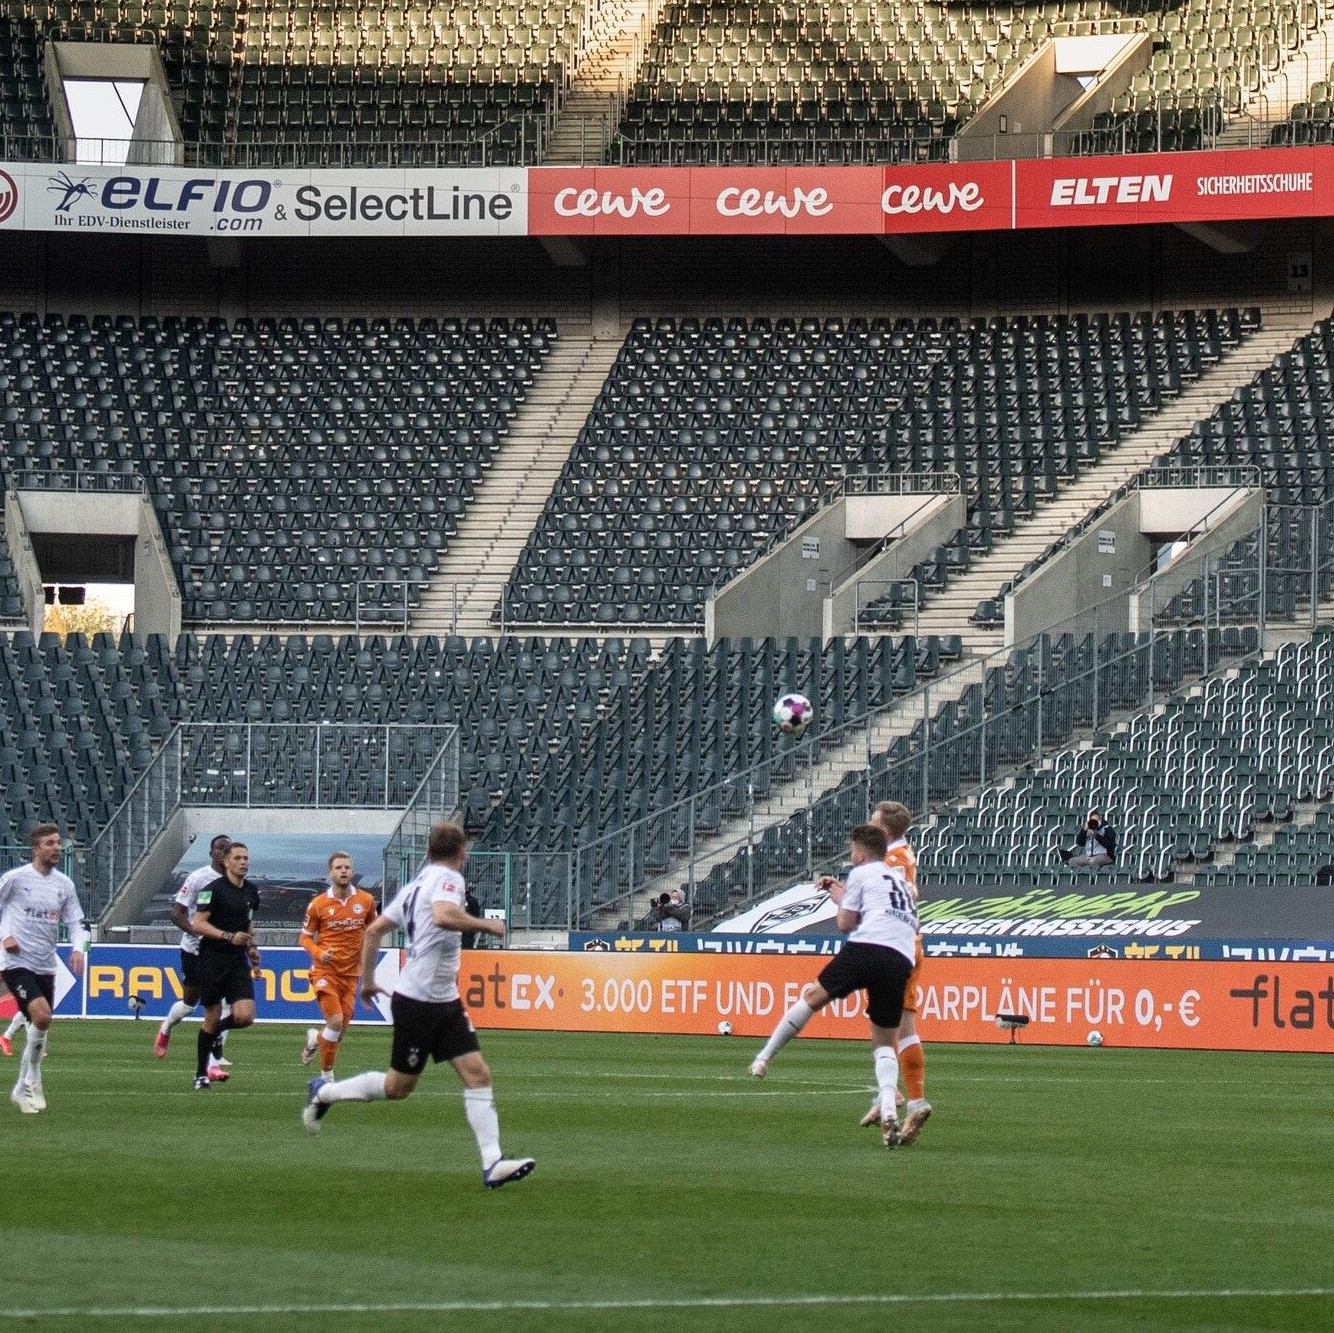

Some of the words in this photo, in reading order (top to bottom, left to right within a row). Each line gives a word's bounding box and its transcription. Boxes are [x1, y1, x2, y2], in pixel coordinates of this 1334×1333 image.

[554, 186, 670, 218] cewe
[716, 186, 834, 218] cewe
[881, 181, 984, 214] cewe
[1050, 174, 1173, 207] ELTEN
[1196, 172, 1314, 197] SICHERHEITSSCHUHE
[53, 214, 75, 227] Ihr
[78, 216, 191, 230] EDV-Dienstleister
[209, 215, 263, 232] .com
[274, 203, 288, 221] &
[919, 917, 1022, 935] GEGEN
[1017, 918, 1202, 937] RASSISMUS
[580, 977, 652, 1013] 3.000
[660, 978, 707, 1015] ETF
[716, 980, 775, 1016] UND
[1066, 978, 1125, 1026] FÜR
